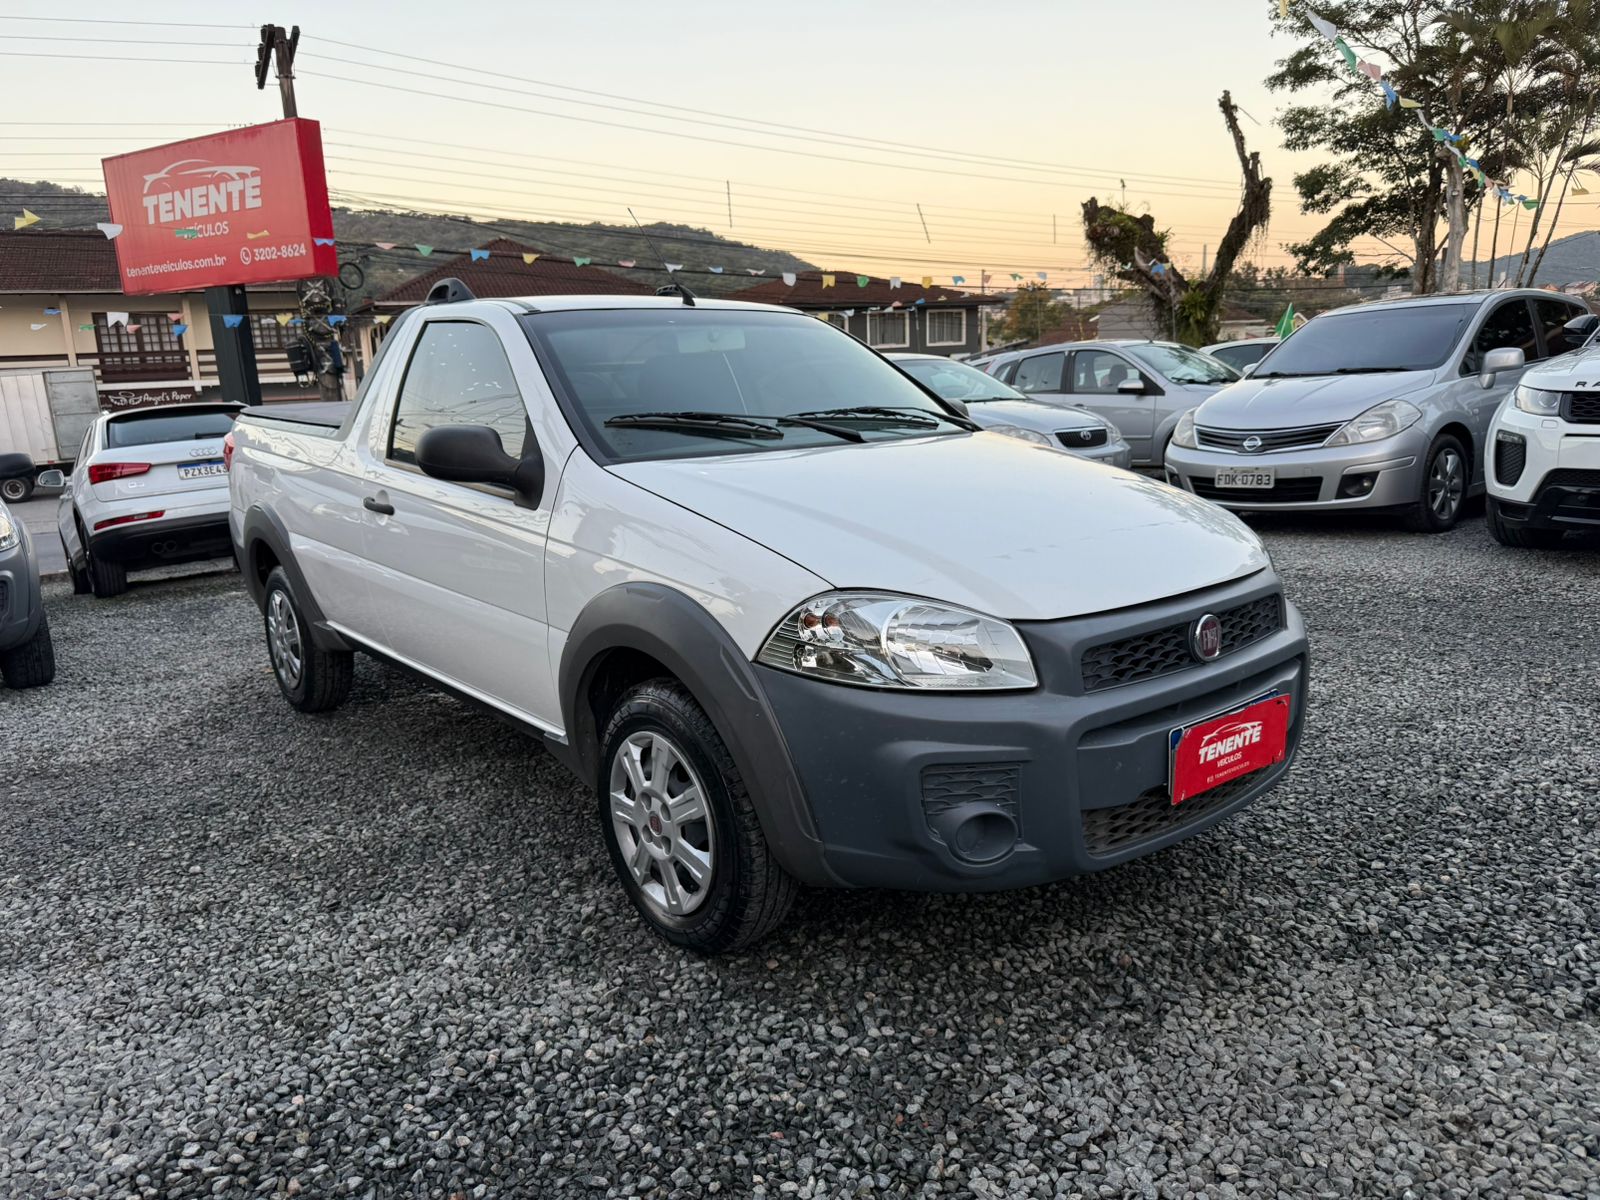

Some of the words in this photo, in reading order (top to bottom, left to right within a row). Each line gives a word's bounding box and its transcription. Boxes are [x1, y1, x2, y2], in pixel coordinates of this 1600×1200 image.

[143, 175, 262, 225] TENENTE
[253, 242, 306, 262] 3202-8624
[126, 254, 227, 278] tenenteveiculos.com.br
[143, 391, 170, 406] Angel's
[1217, 473, 1271, 485] FDK-0783
[1198, 726, 1262, 764] TENENTE
